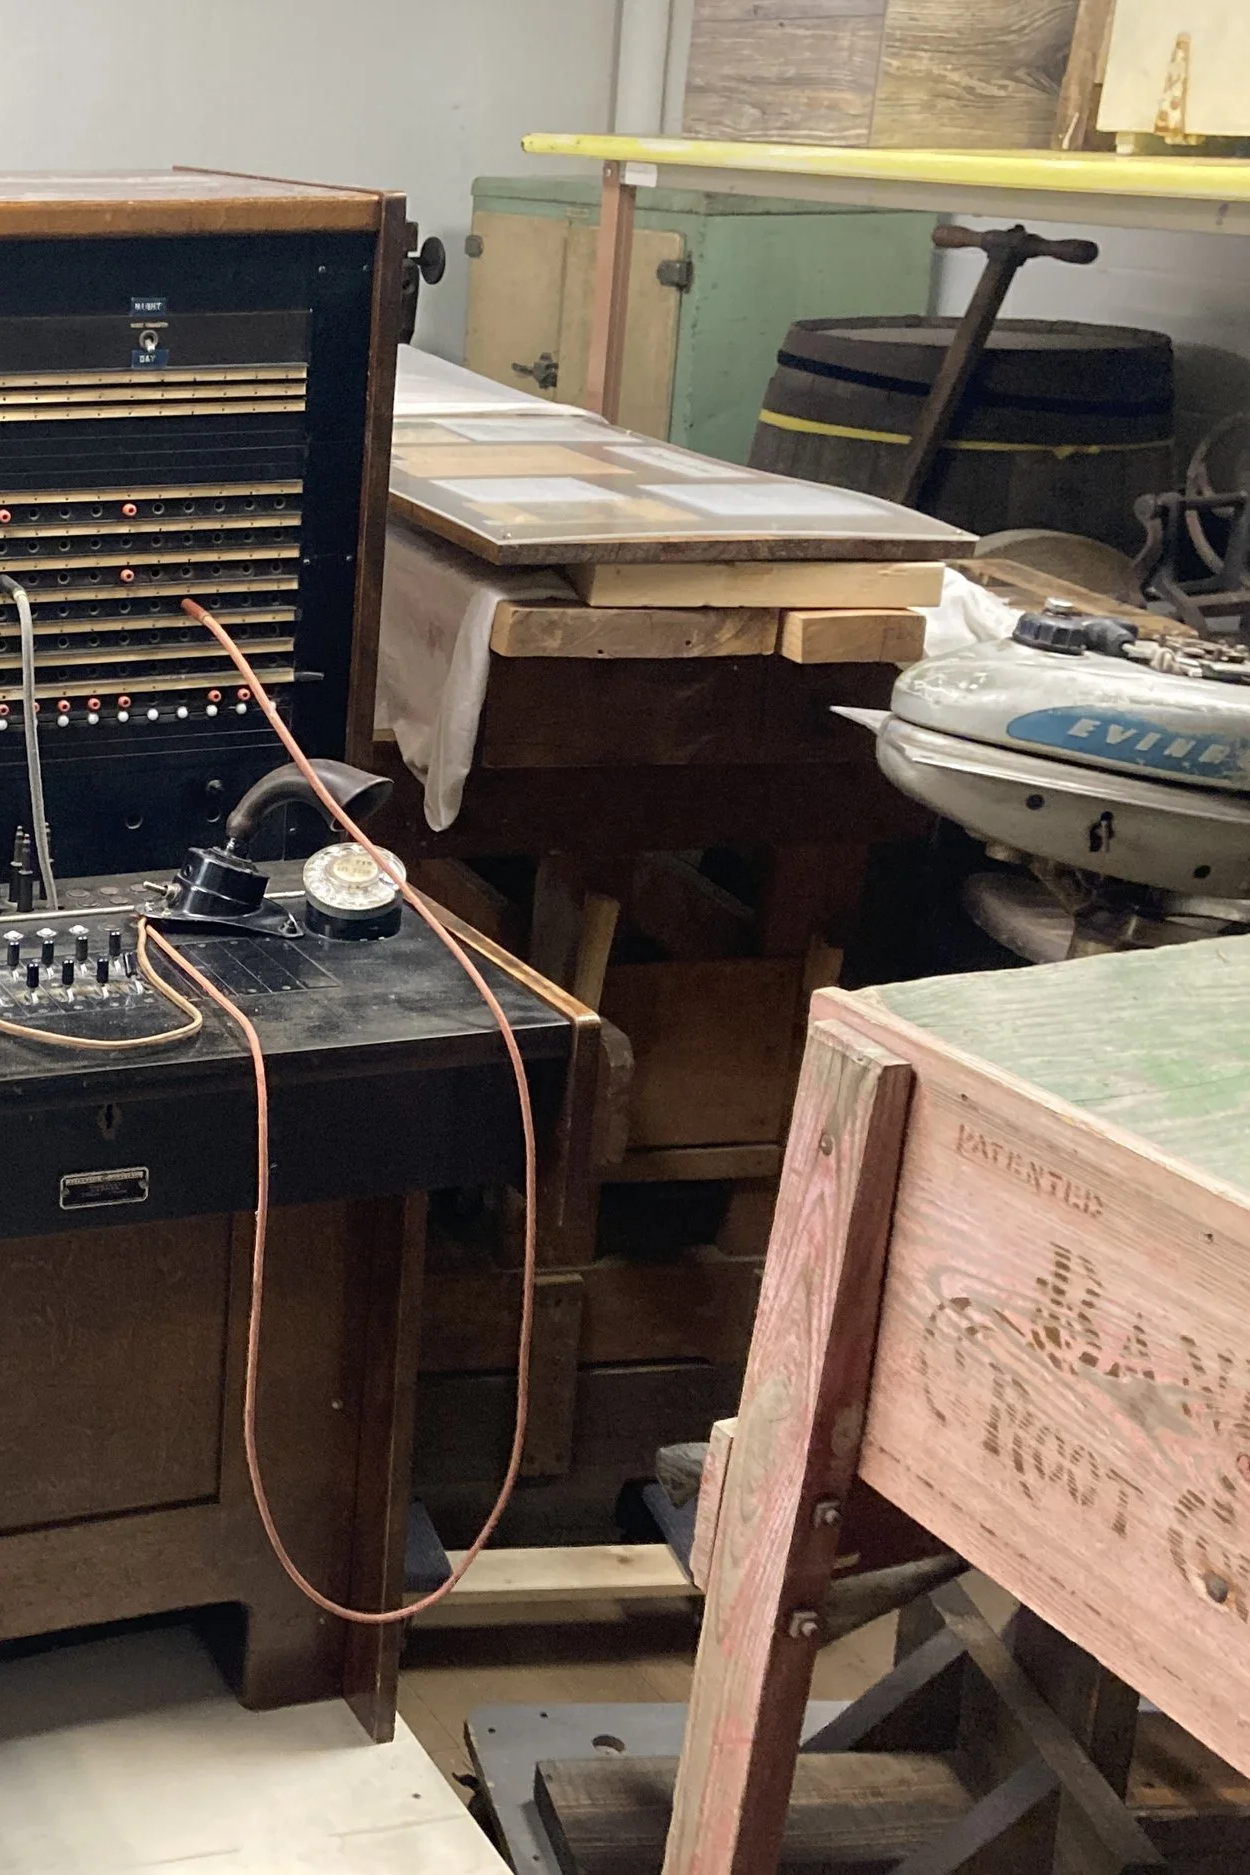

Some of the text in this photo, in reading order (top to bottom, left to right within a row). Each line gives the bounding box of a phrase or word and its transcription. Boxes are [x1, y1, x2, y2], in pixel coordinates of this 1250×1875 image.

[134, 302, 162, 311] NIGHT
[139, 354, 156, 363] DAY
[956, 1123, 1104, 1219] PATENTED
